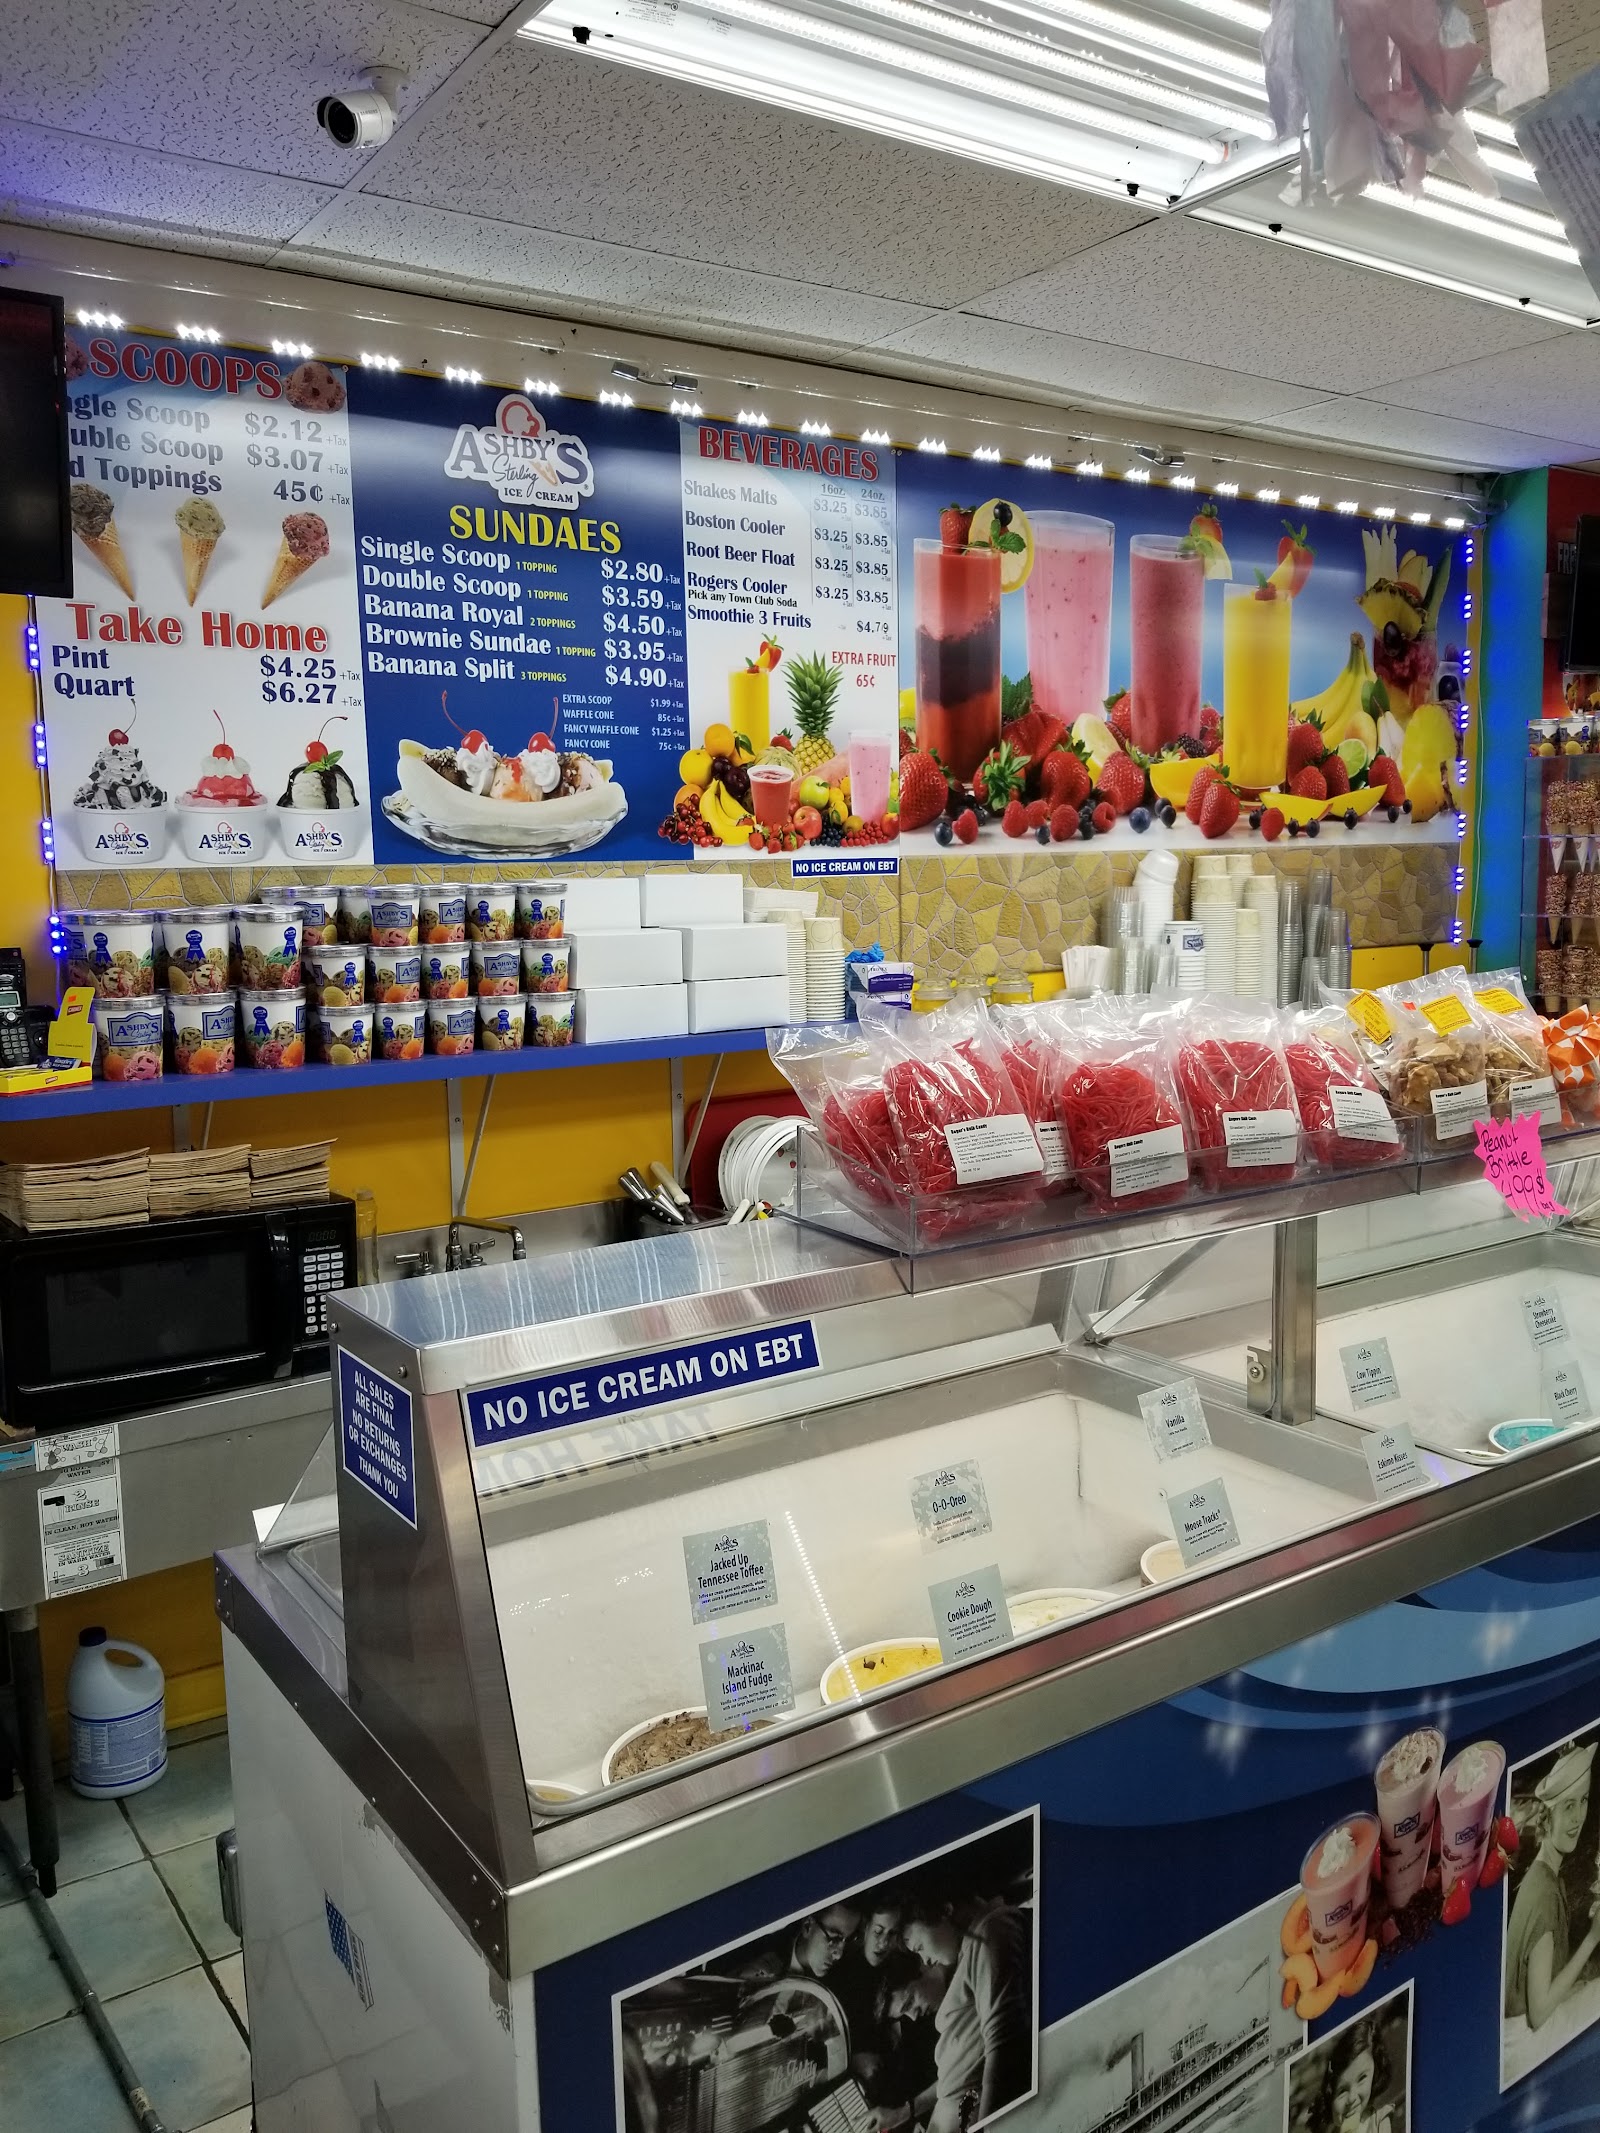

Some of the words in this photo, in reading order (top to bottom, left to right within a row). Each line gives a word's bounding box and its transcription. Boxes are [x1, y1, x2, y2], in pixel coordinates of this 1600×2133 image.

[89, 338, 283, 400] SCOOPS
[126, 398, 211, 433] Scoop
[244, 411, 323, 443] $2.12
[326, 435, 347, 446] +Tax
[70, 425, 131, 451] uble
[141, 431, 223, 465] Scoop
[246, 442, 324, 473] $3.07
[328, 464, 349, 475] +Tax
[450, 430, 589, 484] ASHBY'S
[698, 425, 879, 482] BEVERAGES
[94, 457, 222, 496] Toppings
[273, 479, 323, 503] 45¢
[329, 494, 350, 505] +Tax
[504, 487, 523, 497] ICE
[535, 491, 574, 504] CREAM
[684, 479, 736, 501] Shakes
[740, 486, 778, 505] Malts
[813, 499, 848, 514] $3.25
[854, 503, 888, 519] $3.85
[449, 504, 622, 554] SUNDAES
[685, 510, 736, 531] Boston
[740, 517, 786, 536] Cooler
[814, 527, 848, 543] $3.25
[855, 532, 888, 547] $3.85
[361, 535, 435, 566] Single
[442, 543, 511, 573] Scoop
[522, 561, 558, 574] TOPPING
[601, 557, 663, 583] $2.80
[664, 574, 681, 585] +Tax
[686, 541, 720, 559] Root
[724, 545, 757, 563] Beer
[762, 549, 796, 567] Float
[815, 556, 849, 572] $3.25
[855, 560, 889, 576] $3.85
[363, 564, 446, 592] Double
[453, 572, 521, 602] Scoop
[533, 590, 569, 602] TOPPING
[601, 584, 664, 610] $3.59
[665, 600, 682, 611] +Tax
[687, 571, 738, 592] Rogers
[742, 576, 788, 595] Cooler
[815, 585, 849, 601] $3.25
[856, 589, 889, 604] $3.85
[687, 589, 708, 601] Pick
[710, 593, 727, 603] any
[729, 592, 752, 604] Town
[754, 594, 774, 606] Club
[776, 596, 798, 608] Soda
[65, 602, 183, 645] Take
[201, 610, 328, 653] Home
[364, 593, 455, 622] Banana
[461, 602, 524, 630] Royal
[537, 617, 576, 630] TOPPINGS
[603, 611, 665, 636] $4.50
[666, 626, 683, 637] +Tax
[687, 604, 754, 624] Smoothie
[759, 610, 768, 625] 3
[773, 612, 812, 629] Fruits
[366, 623, 463, 649] Brownie
[470, 629, 551, 655] Sundae
[562, 647, 596, 658] TOPPING
[603, 638, 666, 662] $3.95
[666, 652, 684, 663] +Tax
[832, 651, 864, 666] EXTRA
[867, 653, 897, 667] FRUIT
[52, 645, 110, 669] Pint
[259, 654, 337, 680] $4.25
[339, 670, 361, 682] +Tax
[367, 651, 458, 678] Banana
[464, 657, 515, 682] Split
[527, 671, 567, 682] TOPPINGS
[605, 664, 667, 687] $4.90
[667, 679, 684, 688] +Tax
[856, 674, 875, 688] 65¢
[53, 672, 136, 699] Quart
[261, 680, 337, 705] $6.27
[341, 696, 362, 708] +Tax
[562, 694, 586, 704] EXTRA
[588, 695, 613, 704] SCOOP
[650, 698, 670, 708] $1.99
[563, 709, 593, 719] WAFFLE
[594, 710, 614, 720] CONE
[564, 724, 589, 734] FANCY
[590, 724, 619, 734] WAFFLE
[620, 725, 640, 735] CONE
[651, 727, 672, 737] $1.25
[565, 738, 589, 748] FANCY
[590, 739, 610, 749] CONE
[95, 832, 149, 849] ASHBY'S
[200, 832, 252, 849] ASHBY'S
[295, 831, 342, 848] ASHBY'S
[796, 863, 809, 873] NO
[811, 863, 827, 873] ICE
[828, 862, 861, 872] CREAM
[863, 862, 876, 871] ON
[878, 861, 895, 871] EBT
[1481, 1127, 1518, 1152] Peanut
[1486, 1151, 1532, 1178] Brittle
[354, 1370, 368, 1392] ALL
[369, 1380, 394, 1411] SALES
[483, 1396, 528, 1430] NO
[538, 1382, 589, 1418] ICE
[599, 1357, 702, 1403] CREAM
[710, 1346, 748, 1378] ON
[755, 1333, 803, 1368] EBT
[355, 1389, 370, 1411] ARE
[372, 1402, 395, 1431] FINAL
[1165, 1414, 1186, 1429] Vanilla
[352, 1408, 363, 1429] NO
[364, 1418, 401, 1457] RETURNS
[349, 1424, 359, 1446] OR
[360, 1435, 407, 1482] EXCHANGES
[359, 1455, 382, 1487] THANK
[383, 1472, 399, 1499] YOU
[1184, 1517, 1203, 1533] Moose
[698, 1570, 739, 1589] Tennessee
[740, 1564, 764, 1579] Toffee
[710, 1556, 737, 1573] Jacked
[738, 1554, 749, 1568] Up
[947, 1604, 970, 1622] Cookie
[970, 1598, 993, 1615] Dough
[722, 1678, 747, 1695] Island
[748, 1672, 773, 1689] Fudge
[727, 1660, 765, 1679] Mackinac
